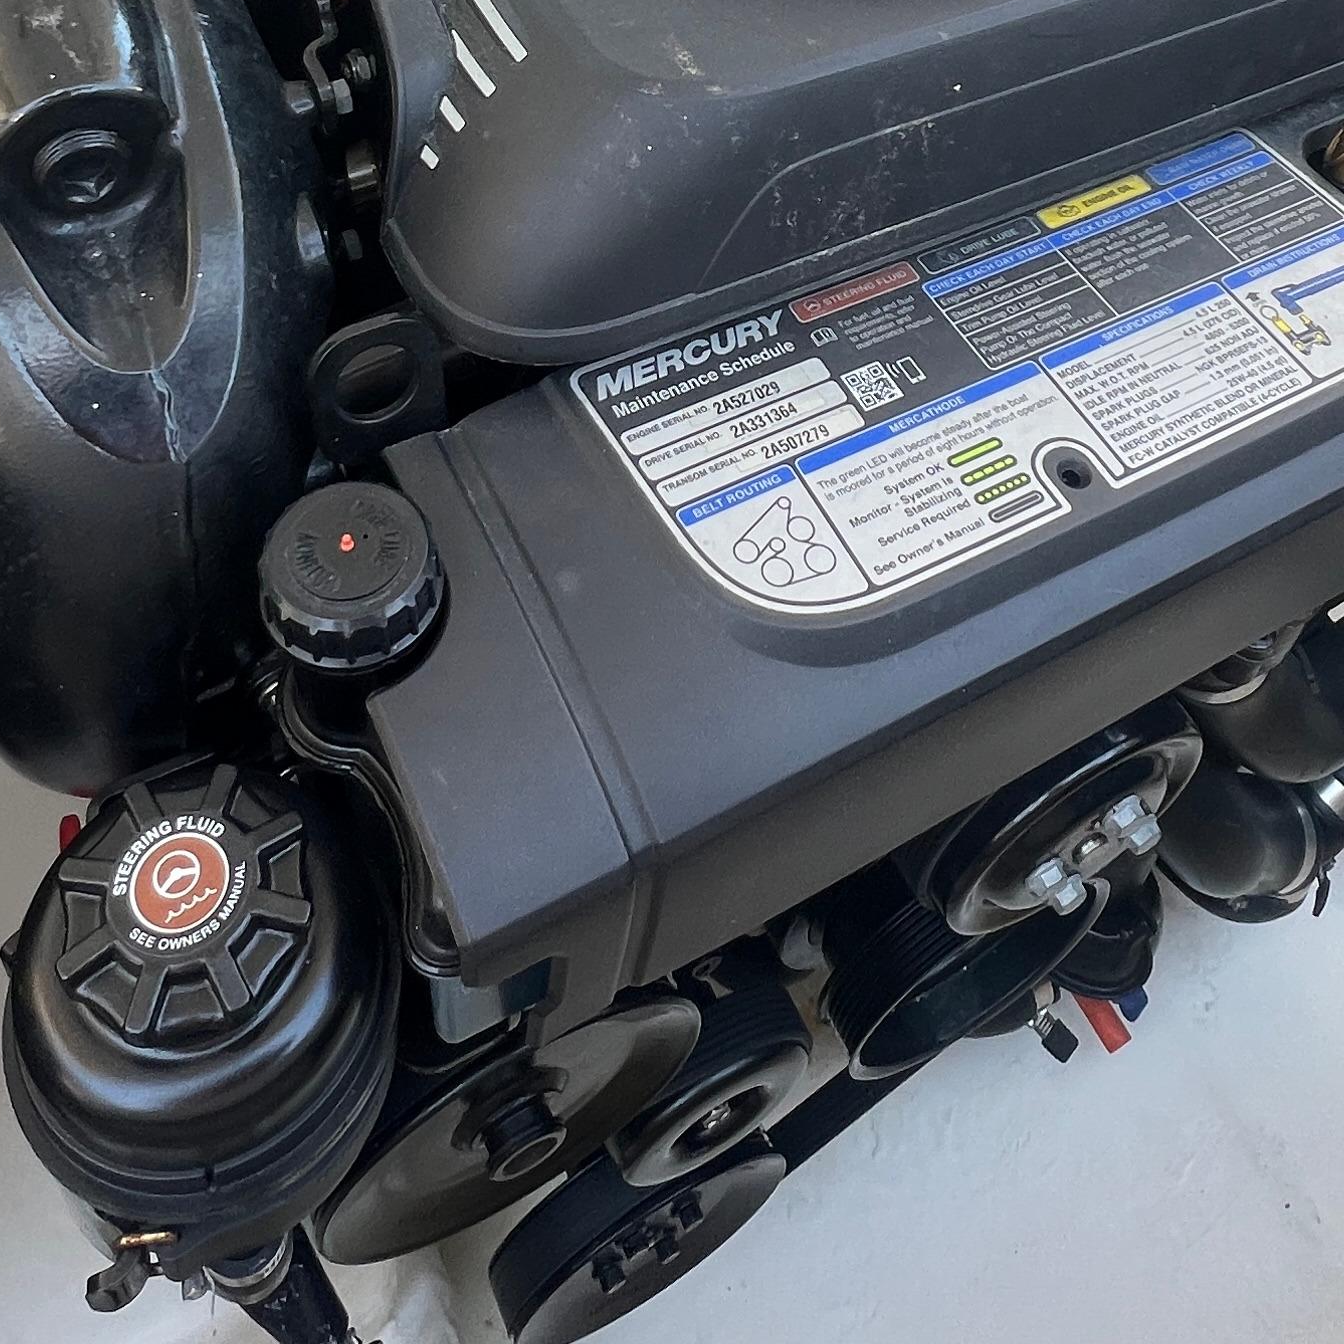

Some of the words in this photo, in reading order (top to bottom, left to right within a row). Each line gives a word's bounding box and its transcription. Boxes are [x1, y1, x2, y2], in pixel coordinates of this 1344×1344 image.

[874, 269, 908, 286] FLUID
[928, 274, 966, 292] CHECK
[965, 263, 995, 278] EACH
[993, 255, 1016, 267] DAY
[1014, 243, 1048, 259] START
[1033, 271, 1060, 286] Level
[1246, 260, 1278, 277] DRAIN
[1274, 233, 1341, 265] INSTRUCTIONS
[938, 289, 970, 306] Engine
[981, 275, 1007, 289] Level
[980, 308, 1007, 324] Pump
[1017, 294, 1044, 309] Level
[979, 338, 1009, 356] Pump
[1033, 311, 1075, 334] Compact
[986, 342, 1029, 365] Hydraulic
[1025, 327, 1063, 348] Steering
[1080, 309, 1106, 325] Level
[1100, 305, 1175, 341] SPECIFICATIONS
[591, 308, 781, 401] MERCURY
[609, 367, 720, 418] Maintenance
[716, 338, 797, 377] Schedule
[1056, 359, 1091, 379] MODEL
[1064, 352, 1138, 389] DISPLACEMENT
[1082, 395, 1107, 410] IDLE
[1104, 385, 1128, 400] RPM
[1126, 380, 1140, 390] IN
[1136, 360, 1183, 385] NEUTRAL
[1239, 325, 1260, 339] ADJ
[1073, 383, 1100, 400] MAX.
[1125, 361, 1150, 376] RPM
[1091, 400, 1126, 420] SPARK
[1123, 385, 1159, 406] PLUGS
[1193, 358, 1217, 373] NGK
[625, 423, 662, 442] ENGINE
[660, 410, 694, 428] SERIAL
[710, 379, 782, 415] 2A527029
[887, 394, 966, 433] MERCATHODE
[1099, 411, 1135, 431] SPARK
[1132, 398, 1162, 416] PLUG
[1160, 388, 1183, 403] GAP
[1109, 419, 1148, 442] ENGINE
[1144, 411, 1165, 425] OIL
[1118, 426, 1166, 453] MERCURY
[1163, 402, 1216, 431] SYNTHETIC
[1213, 388, 1246, 408] BLEND
[1243, 381, 1261, 393] OR
[1257, 363, 1298, 387] MINERAL
[1127, 445, 1157, 464] FC-W
[1153, 424, 1202, 451] CATALYST
[1199, 397, 1259, 430] COMPATIBLE
[1256, 376, 1302, 403] (4-CYCLE)
[643, 450, 673, 467] DRIVE
[672, 436, 707, 455] SERIAL
[727, 401, 799, 438] 2A331364
[661, 468, 708, 492] TRANSOM
[708, 454, 742, 473] SERIAL
[759, 422, 831, 460] 2A507279
[832, 473, 873, 497] moored
[892, 450, 926, 471] period
[922, 446, 937, 457] of
[933, 435, 960, 453] eight
[956, 424, 986, 442] hours
[982, 411, 1017, 431] without
[815, 475, 839, 491] The
[836, 462, 868, 482] green
[864, 453, 890, 470] LED
[886, 446, 906, 460] will
[902, 430, 942, 453] become
[882, 470, 926, 496] System
[924, 462, 945, 476] OK
[691, 498, 725, 518] BELT
[724, 473, 782, 503] ROUTING
[848, 502, 894, 528] Monitor
[899, 479, 944, 505] System
[902, 484, 963, 518] Stabilizing
[872, 558, 898, 576] See
[896, 536, 945, 565] Owner's
[942, 516, 986, 542] Manual
[876, 521, 922, 547] Service
[919, 497, 973, 528] Required
[113, 820, 172, 896] STEERING
[176, 816, 225, 838] FLUID
[129, 928, 156, 949] SEE
[158, 919, 221, 950] OWNERS
[218, 860, 246, 921] MANUAL
